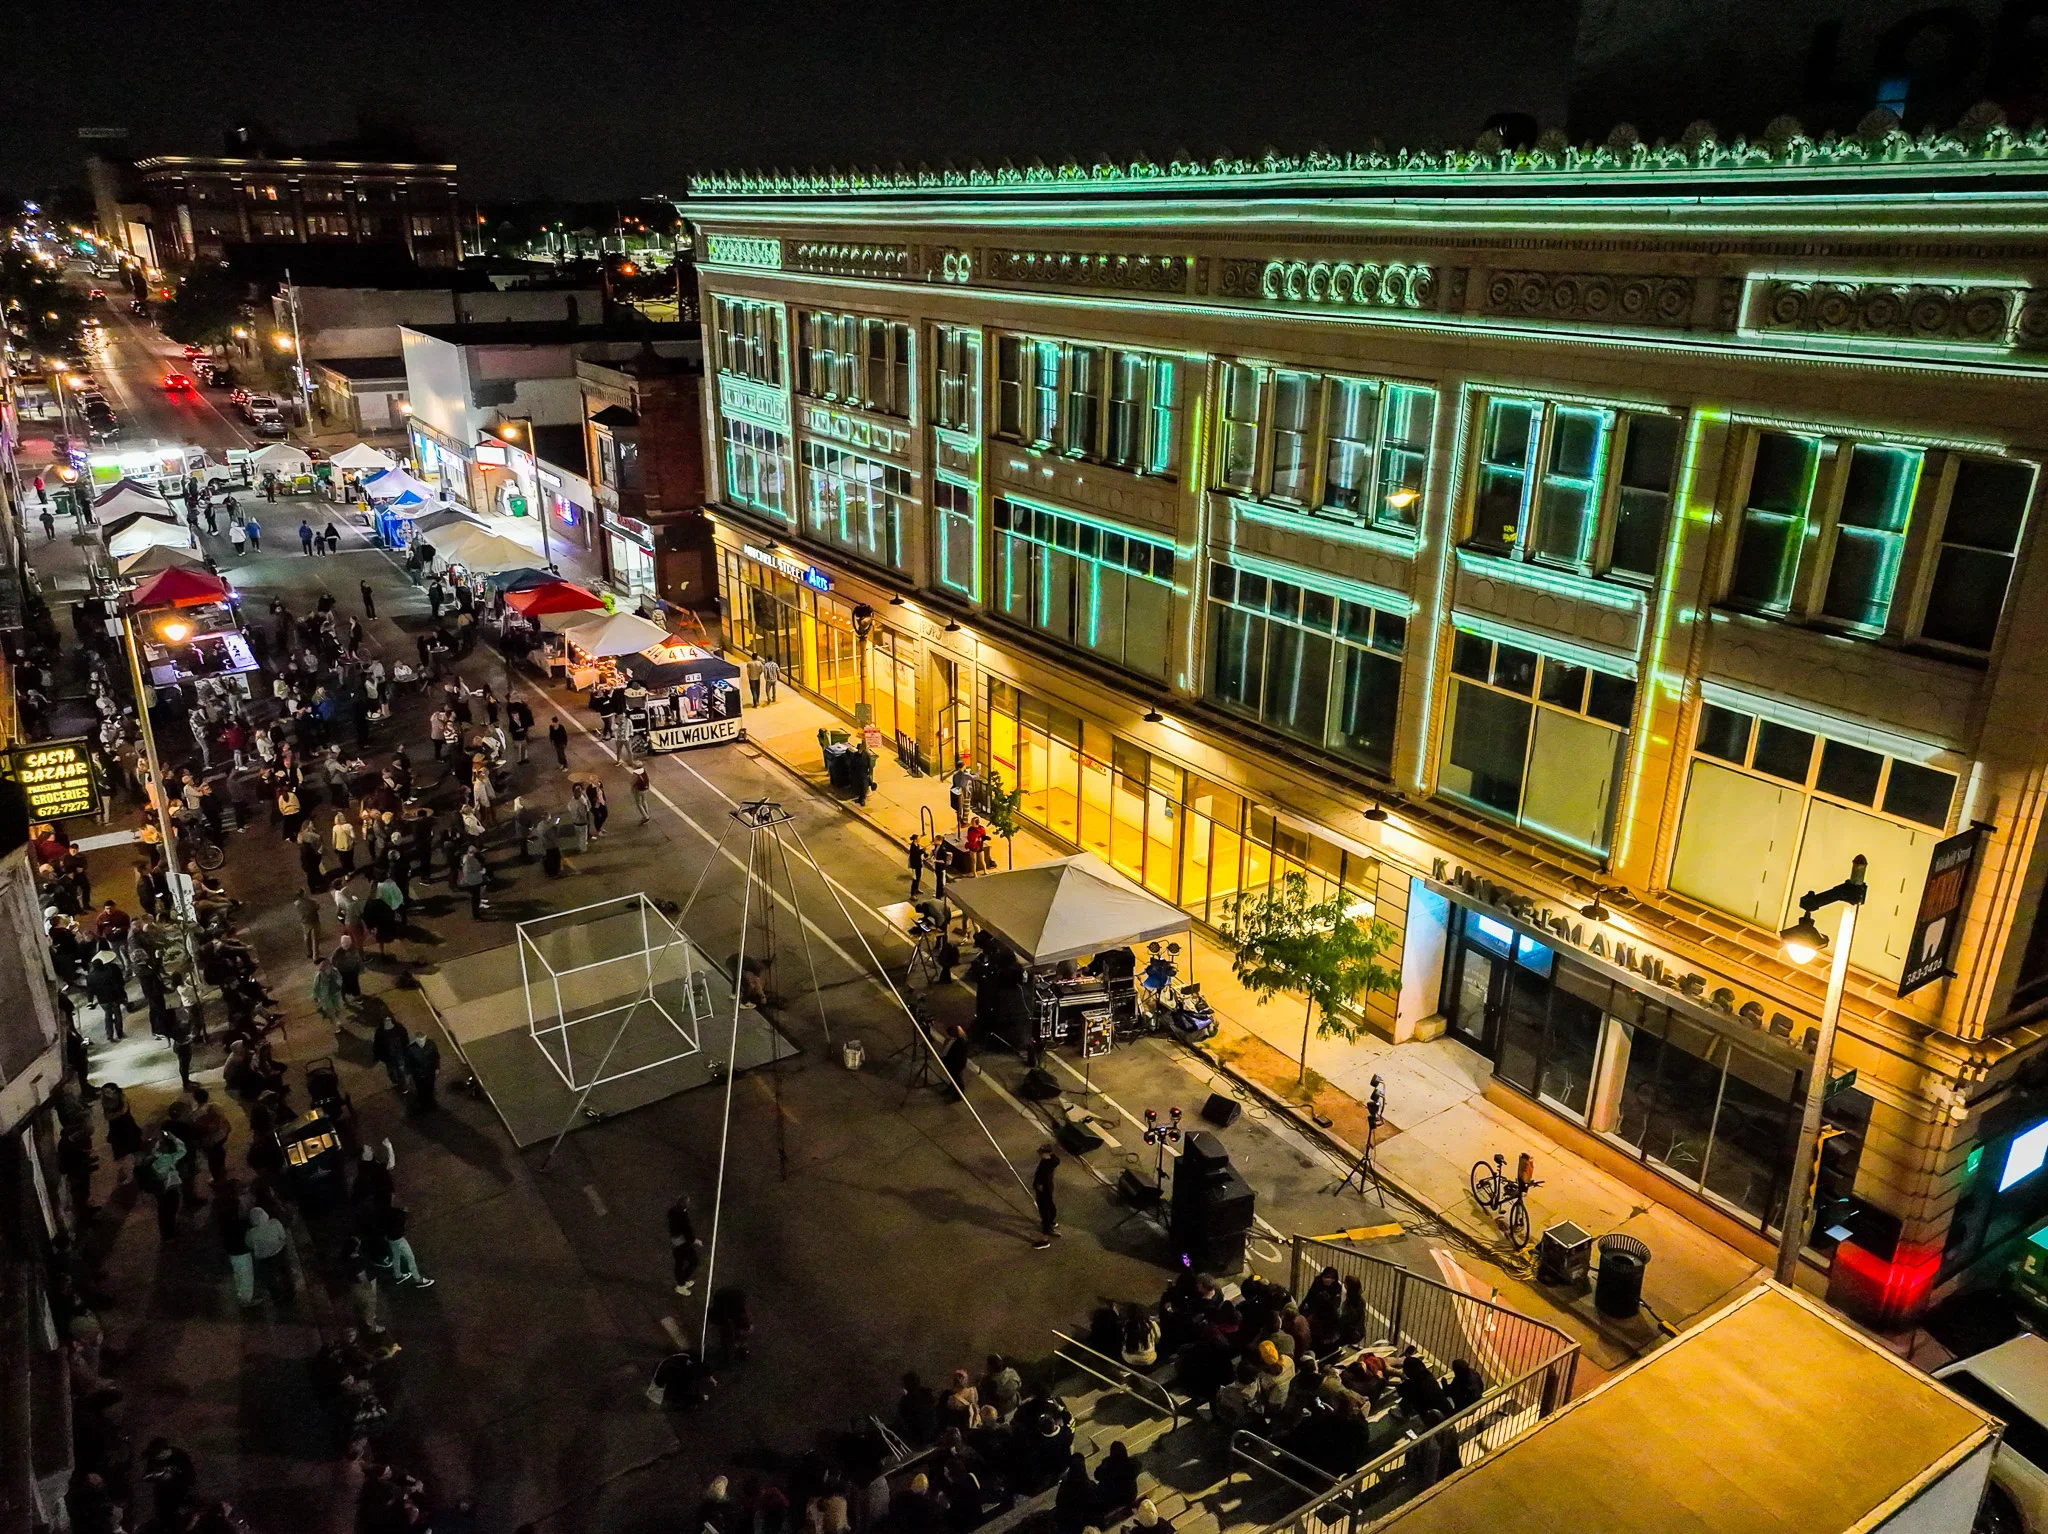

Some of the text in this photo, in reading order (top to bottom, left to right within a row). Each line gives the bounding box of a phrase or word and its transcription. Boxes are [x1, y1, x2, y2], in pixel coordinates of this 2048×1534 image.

[743, 544, 778, 569] MITCHELL
[778, 560, 805, 582] STREET
[668, 647, 698, 660] 414
[685, 674, 701, 682] 414
[658, 721, 736, 748] MILWAUKEE
[25, 748, 76, 768] SASTA
[20, 762, 88, 783] BAZAAR
[31, 787, 90, 806] GROCERIES
[37, 800, 90, 817] 672-7272
